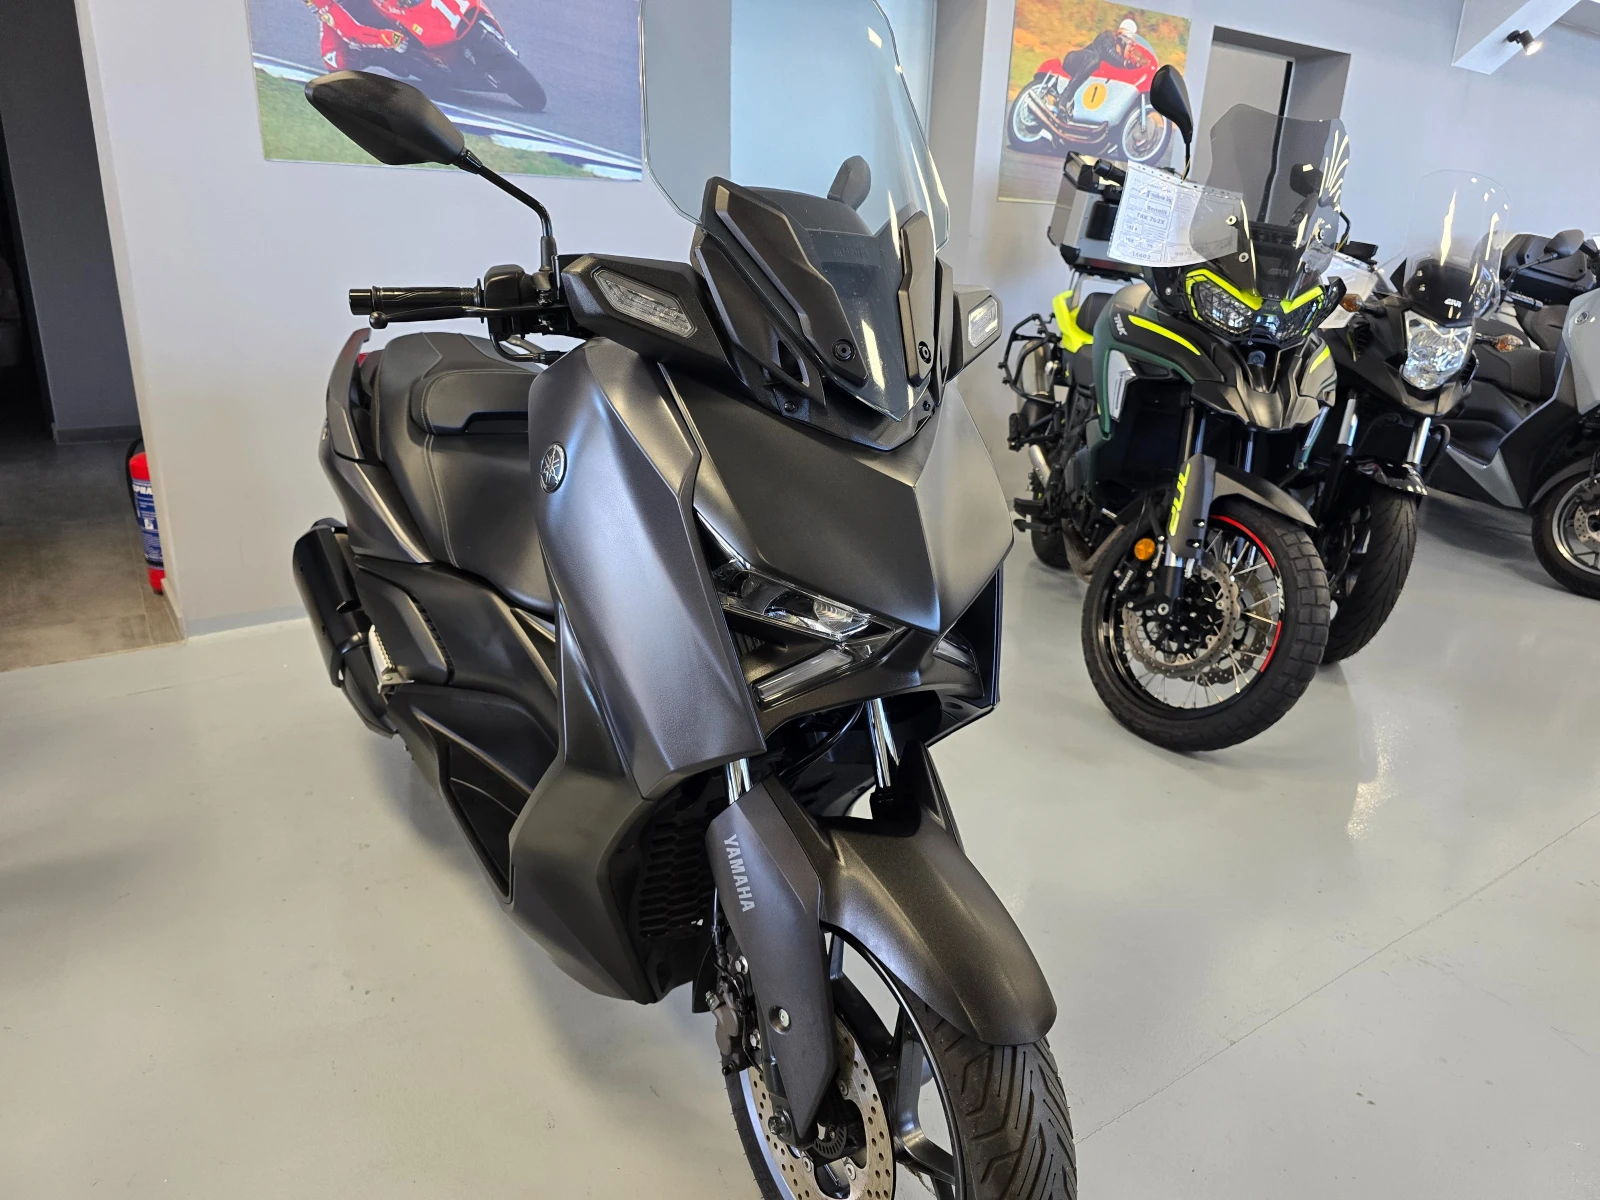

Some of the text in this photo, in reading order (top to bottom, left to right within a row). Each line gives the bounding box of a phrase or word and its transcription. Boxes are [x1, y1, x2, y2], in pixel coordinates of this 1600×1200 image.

[1090, 86, 1098, 103] 1
[1444, 297, 1462, 308] GIVI
[1113, 312, 1128, 336] TRK
[723, 833, 756, 913] YAMAHA
